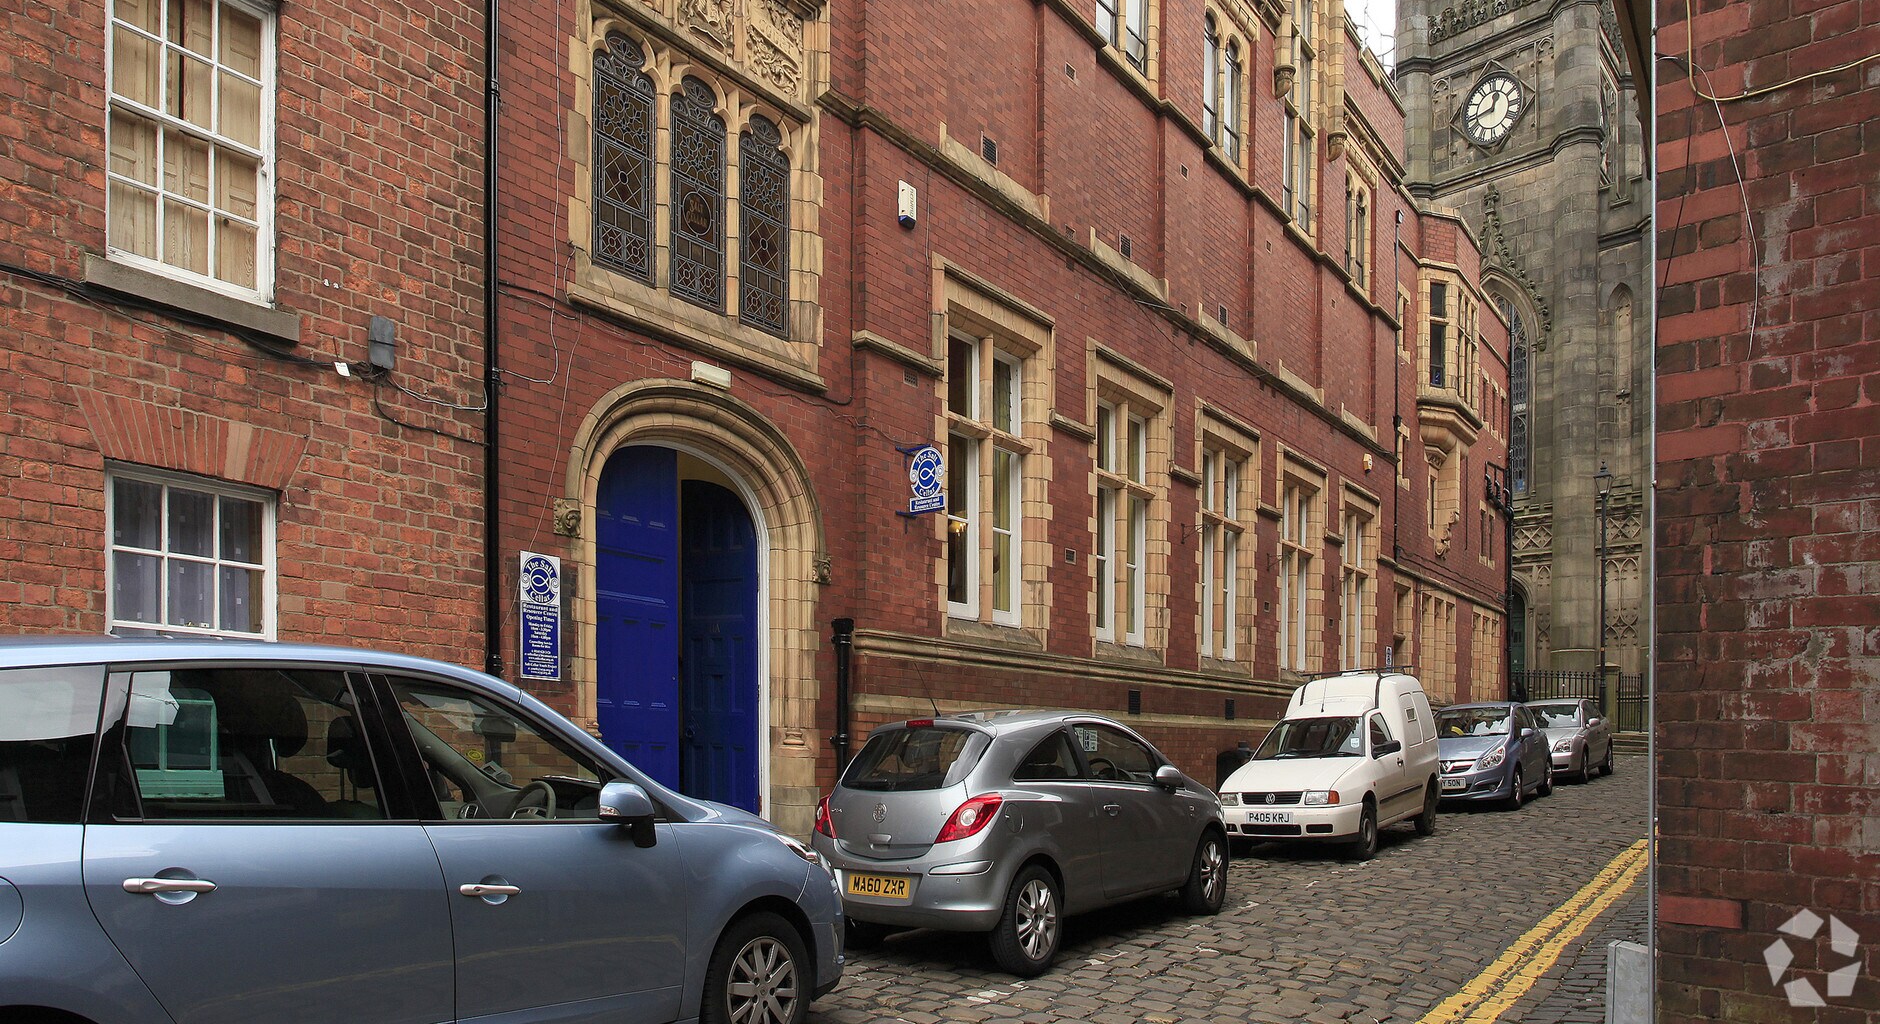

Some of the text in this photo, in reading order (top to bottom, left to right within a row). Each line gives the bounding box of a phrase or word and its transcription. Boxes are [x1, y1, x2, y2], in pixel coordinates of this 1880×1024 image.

[916, 452, 937, 463] The Salt
[919, 487, 935, 496] Cellar
[526, 560, 553, 575] The Salt
[530, 591, 551, 602] Cellar
[522, 603, 549, 611] Restaurant
[526, 614, 543, 622] Opening
[1249, 813, 1290, 823] P405 KRJ
[853, 876, 906, 895] MA60 ZXR
